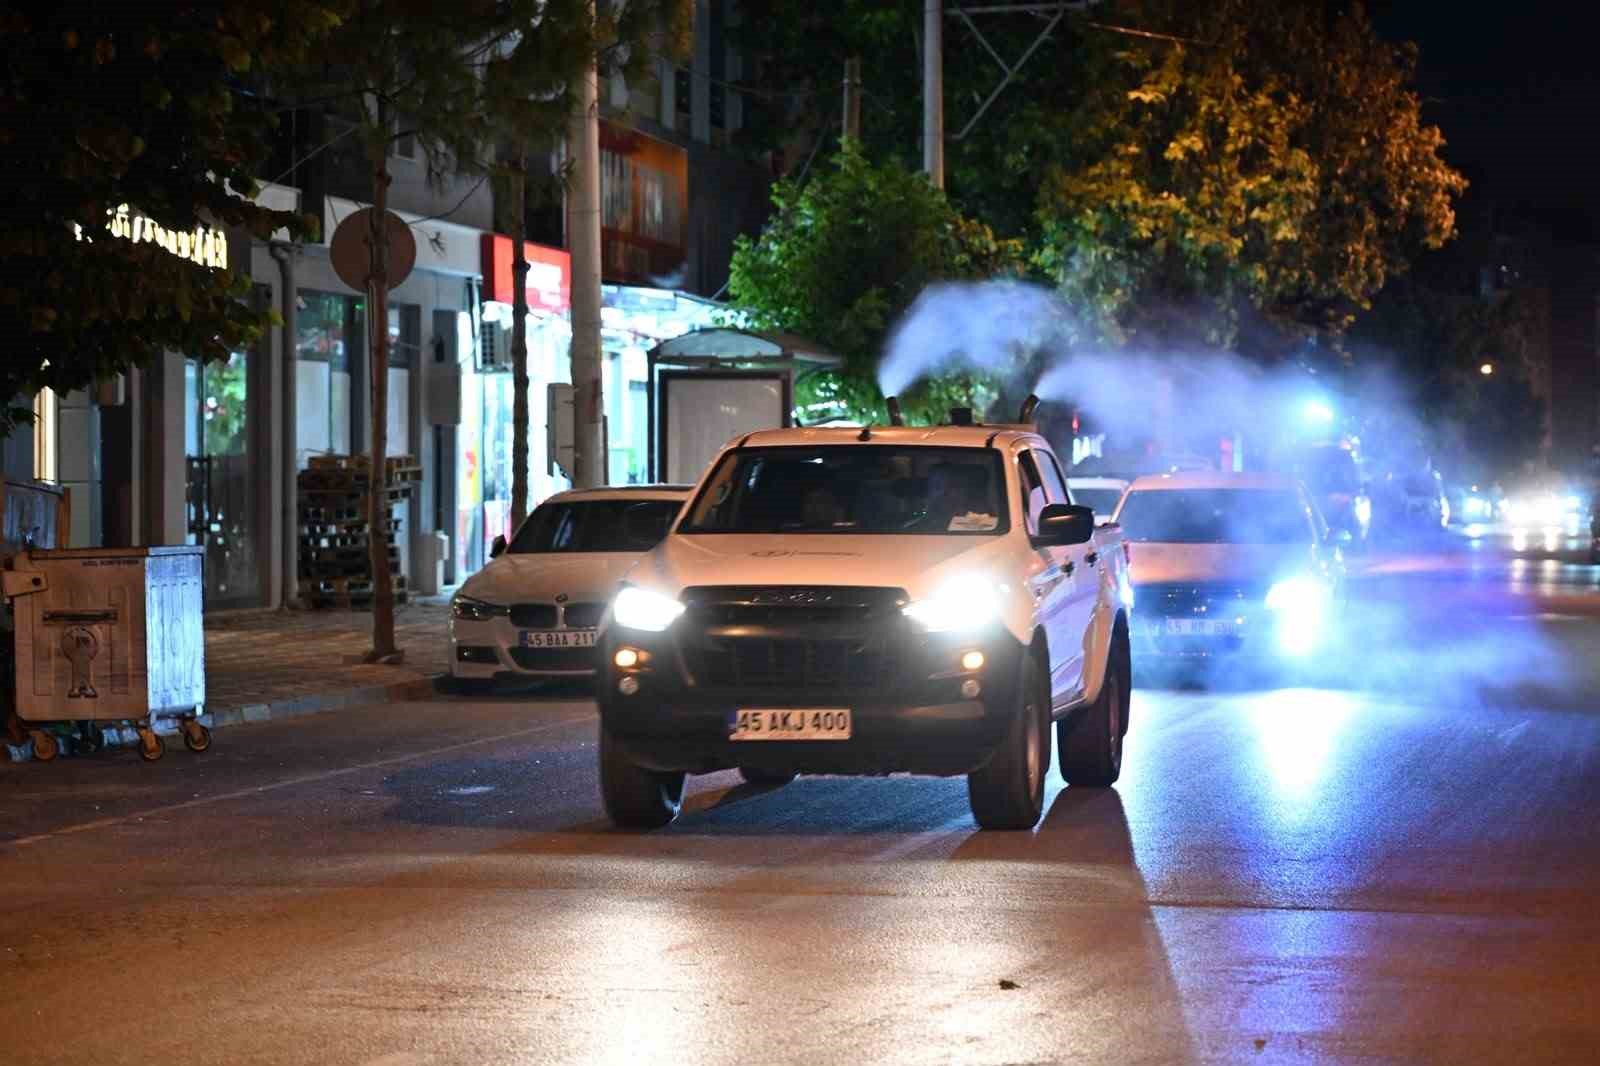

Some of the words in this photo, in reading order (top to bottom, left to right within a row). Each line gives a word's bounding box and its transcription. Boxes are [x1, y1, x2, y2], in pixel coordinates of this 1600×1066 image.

[528, 633, 542, 646] 45
[737, 711, 763, 732] 45
[768, 711, 806, 732] AKJ
[811, 711, 848, 732] 400
